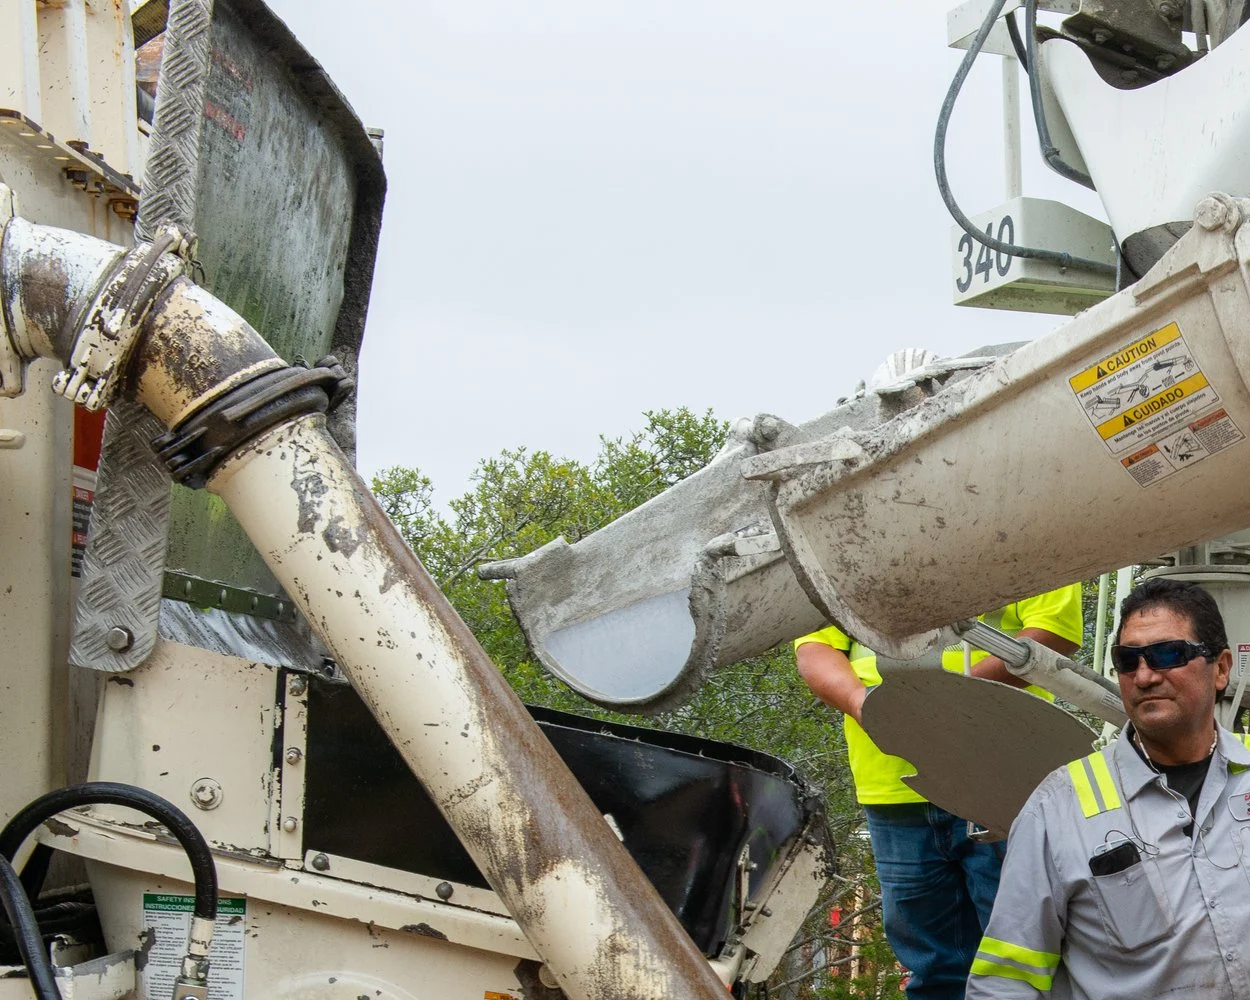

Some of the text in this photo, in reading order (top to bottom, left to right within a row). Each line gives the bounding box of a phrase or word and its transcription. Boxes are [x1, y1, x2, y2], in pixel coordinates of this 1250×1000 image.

[956, 215, 1014, 293] 340
[1079, 388, 1093, 398] Keep
[1091, 380, 1107, 392] hands
[1105, 374, 1117, 384] and
[1115, 368, 1129, 379] body
[1128, 362, 1142, 372] away
[1140, 355, 1153, 365] from
[1151, 348, 1165, 359] pivot
[1104, 337, 1158, 372] CAUTION
[1113, 428, 1137, 443] Mantenga
[1168, 402, 1186, 414] cuerpo
[1131, 386, 1185, 421] CUIDADO
[144, 903, 195, 911] INSTRUCCIONES
